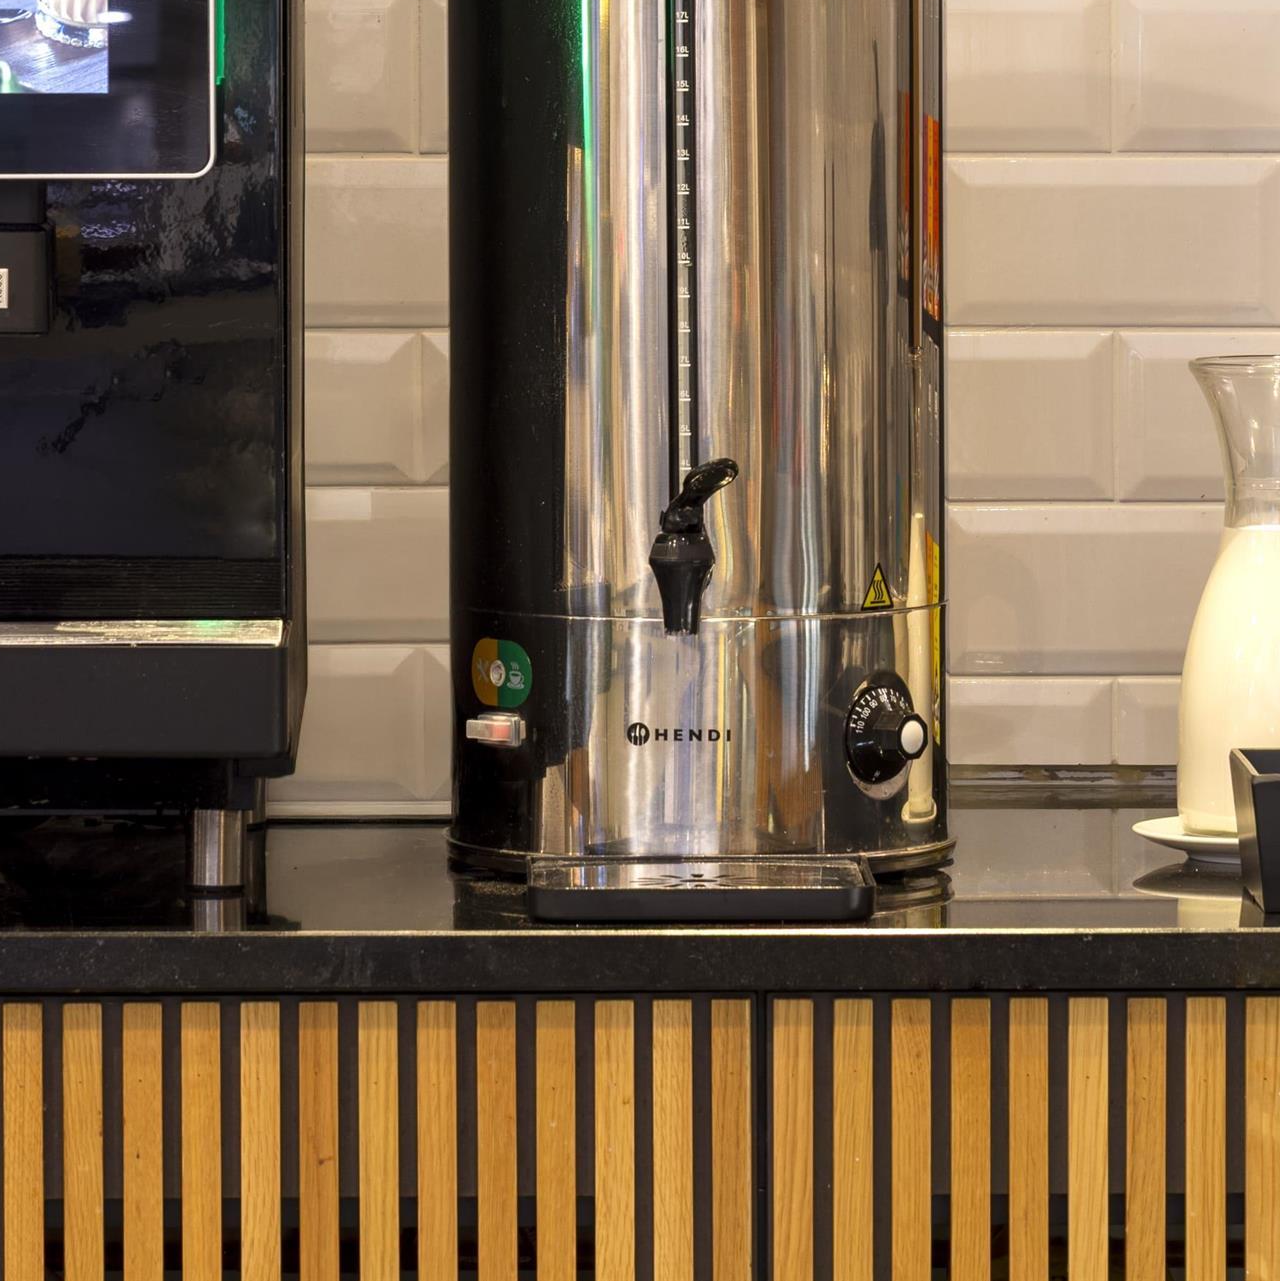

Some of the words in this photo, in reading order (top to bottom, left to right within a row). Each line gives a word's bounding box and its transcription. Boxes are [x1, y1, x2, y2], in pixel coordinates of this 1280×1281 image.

[856, 721, 865, 733] 110
[861, 707, 871, 719] 100
[869, 700, 878, 708] 90
[655, 729, 731, 741] HENDI
